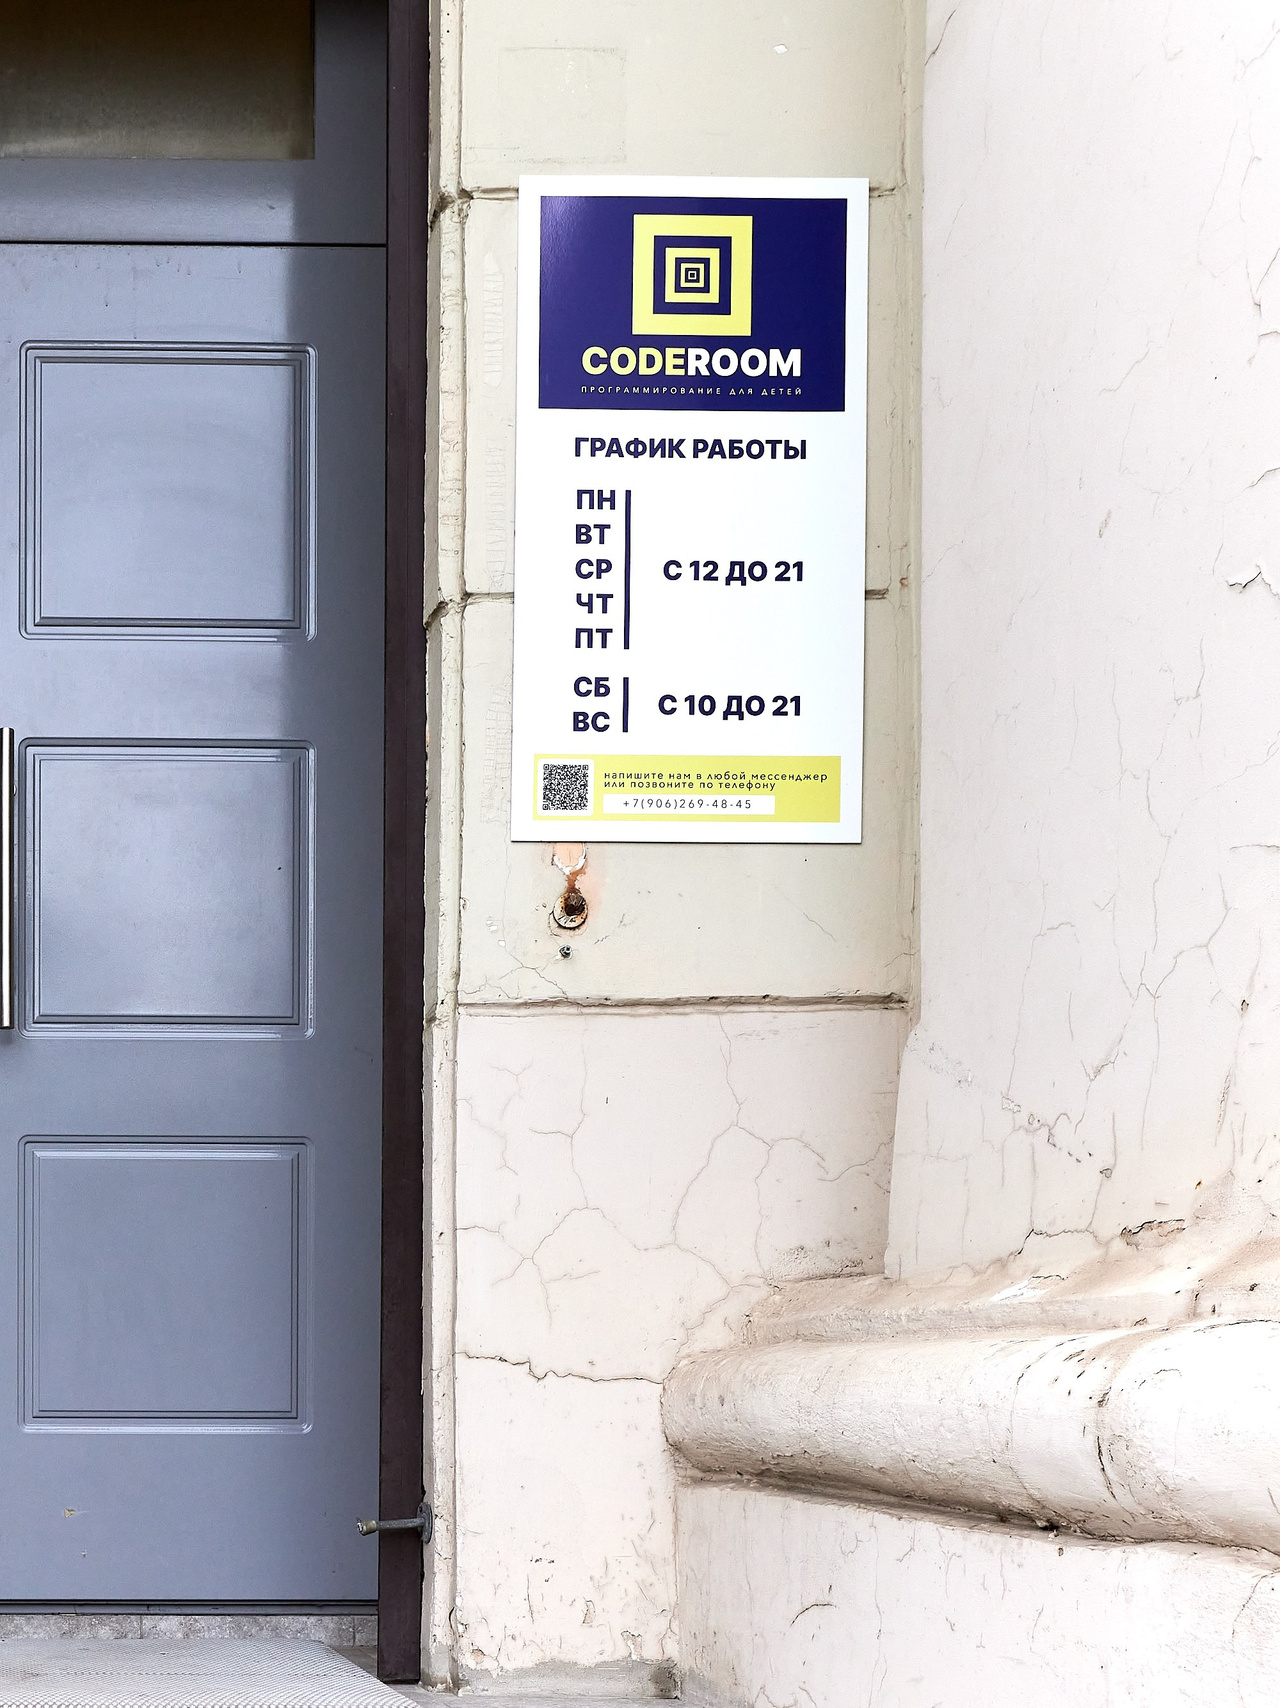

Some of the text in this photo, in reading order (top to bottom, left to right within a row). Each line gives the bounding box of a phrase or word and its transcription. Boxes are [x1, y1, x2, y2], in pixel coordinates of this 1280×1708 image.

[582, 347, 801, 376] CODEROOM
[582, 386, 720, 394] ПРОГРАММИРОВАНИЕ
[575, 437, 806, 459] ГРАФИК РАБОТЫ
[577, 490, 615, 510] ПН
[576, 524, 611, 544] ВТ
[575, 559, 612, 579] СР
[664, 560, 803, 586] С 12 ДО 21
[577, 593, 613, 613] ЧТ
[575, 628, 613, 648] ПТ
[574, 677, 610, 697] СБ
[659, 695, 800, 720] С 10 ДО 21
[573, 712, 610, 732] ВС
[707, 771, 745, 780] любой
[752, 774, 827, 782] мессенджер
[719, 780, 775, 791] телефону
